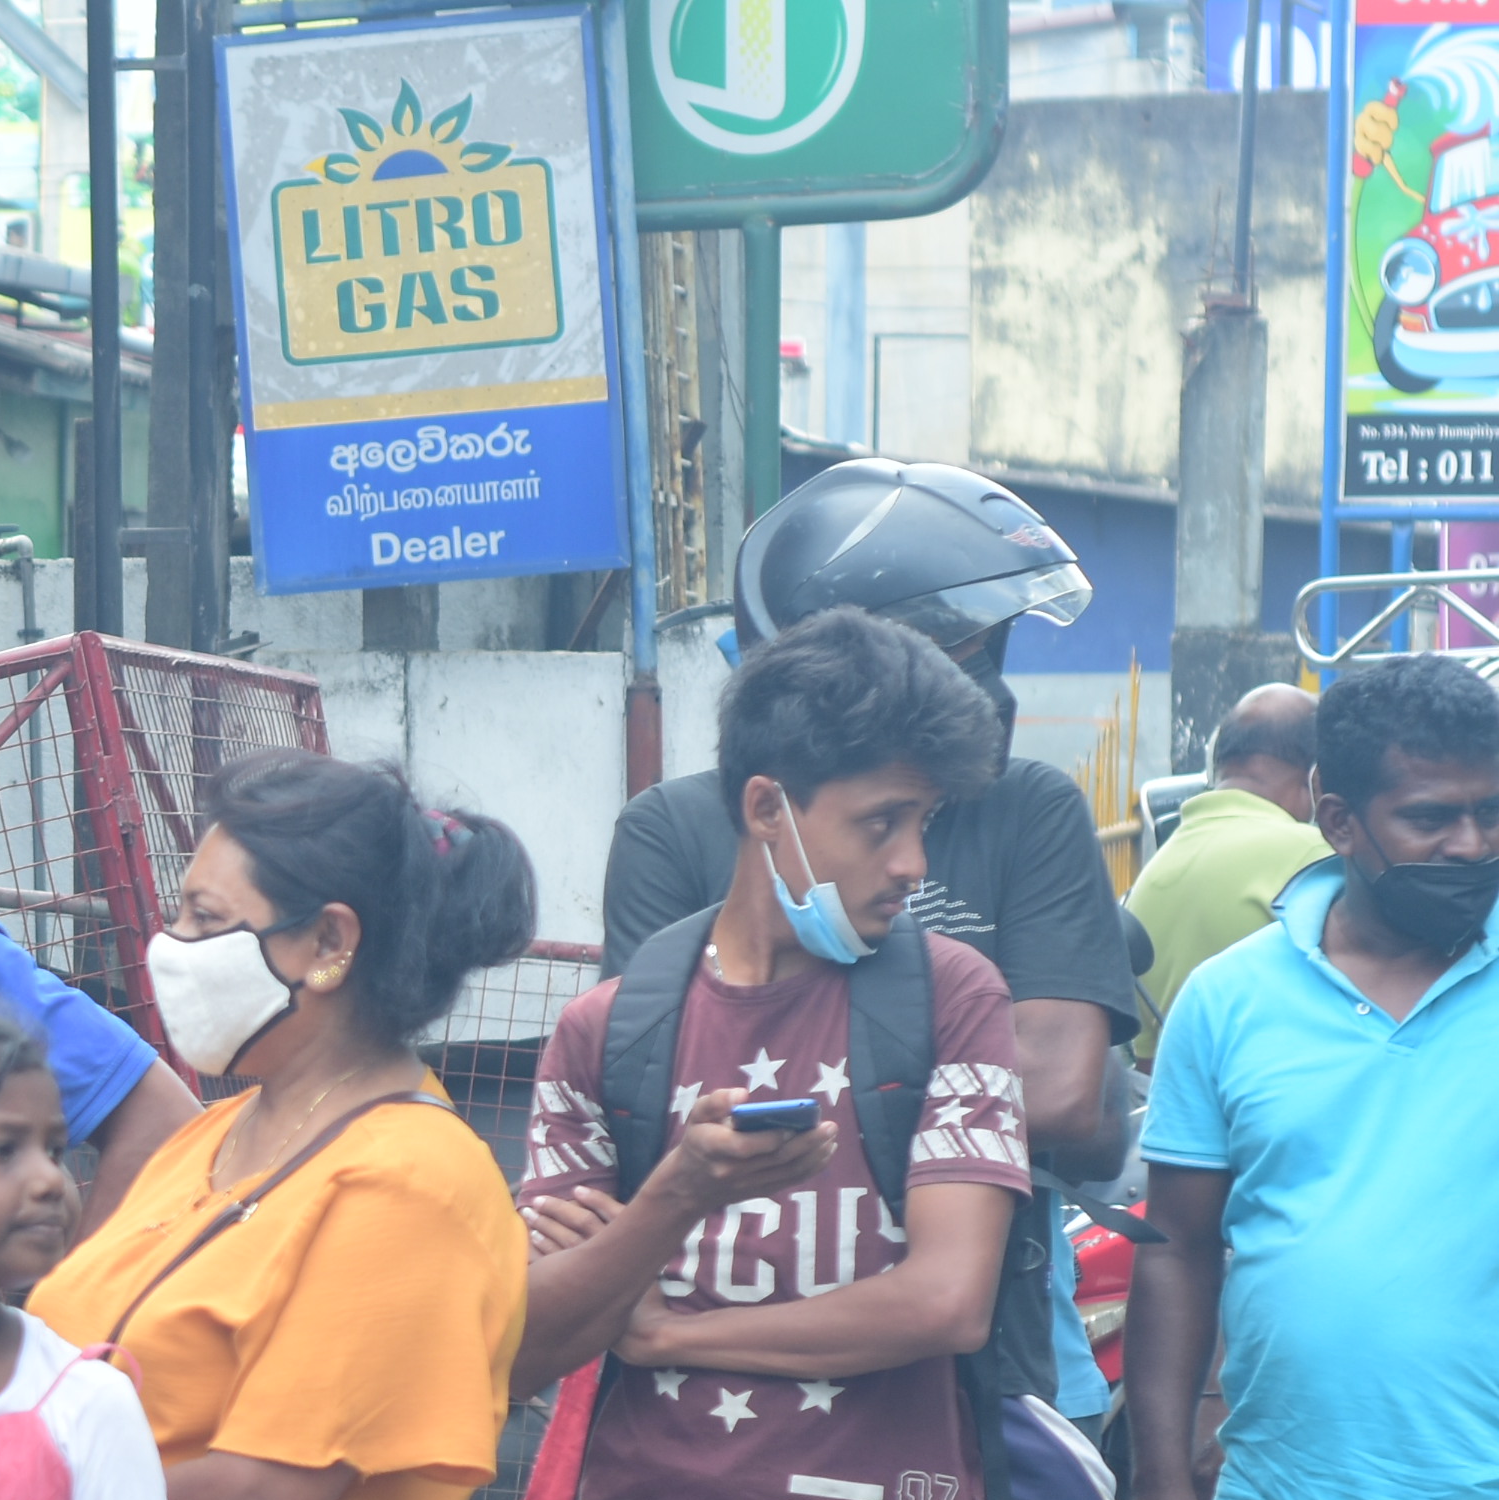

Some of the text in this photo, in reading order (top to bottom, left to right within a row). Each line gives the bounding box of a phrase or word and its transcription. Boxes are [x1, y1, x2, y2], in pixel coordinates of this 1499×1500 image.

[302, 190, 523, 264] LITRO
[336, 265, 501, 334] GAS
[329, 424, 532, 477] අලෙවිකරු
[1411, 424, 1436, 438] New
[1359, 448, 1409, 484] Tel
[1437, 448, 1494, 485] 011
[326, 470, 542, 522] விற்பனையாளர்
[371, 527, 505, 566] Dealer
